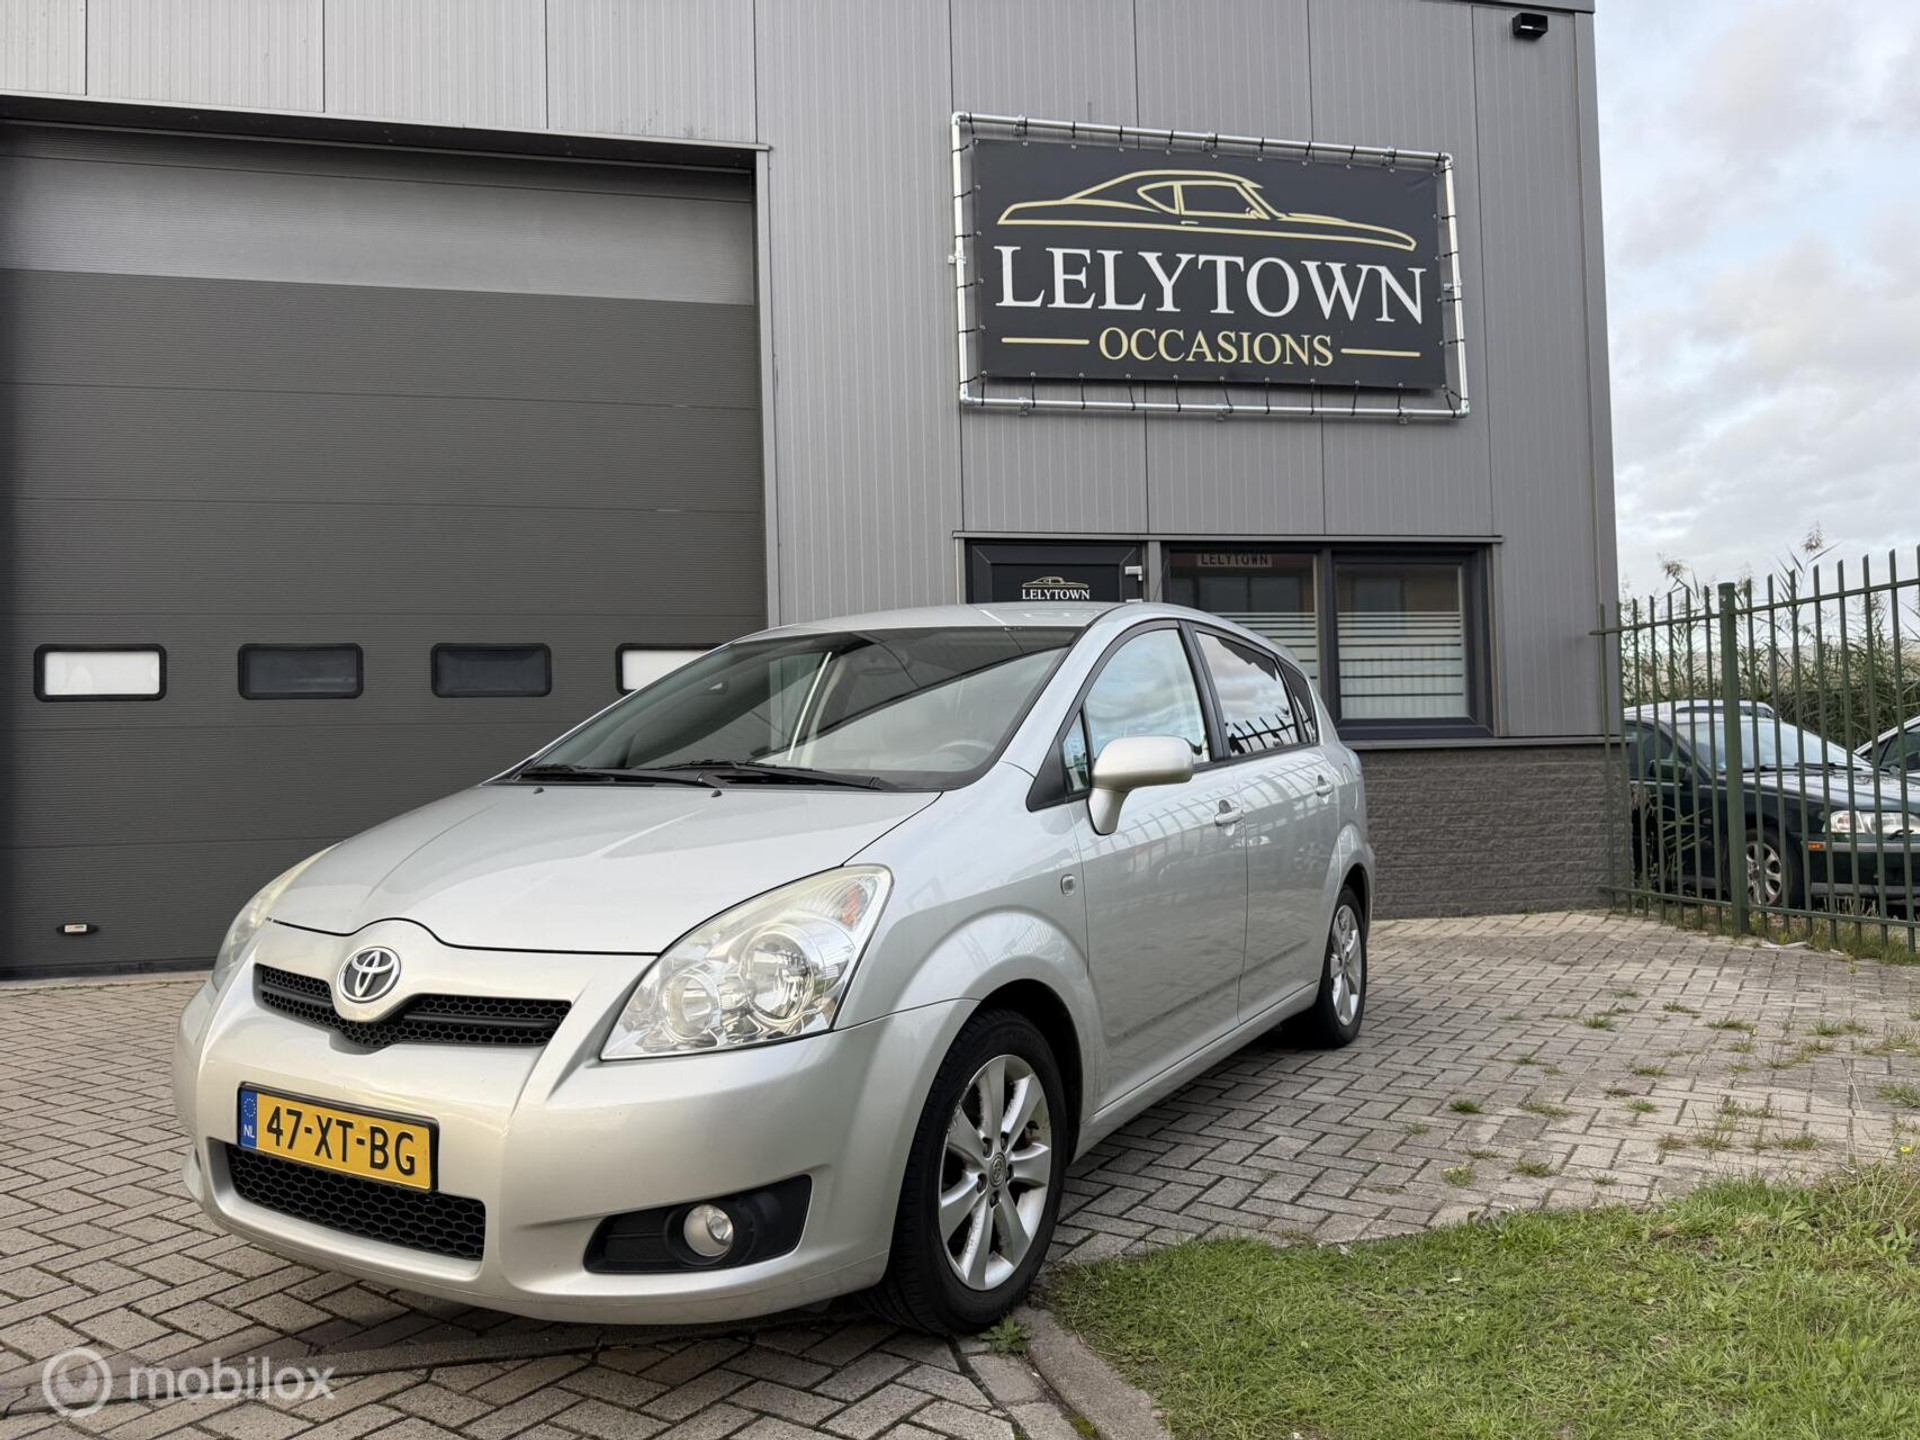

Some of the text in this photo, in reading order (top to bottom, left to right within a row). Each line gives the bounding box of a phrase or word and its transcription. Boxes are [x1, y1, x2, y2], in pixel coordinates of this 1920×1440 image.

[994, 245, 1427, 325] LELYTOWN
[1099, 327, 1334, 367] OCCASIONS
[1200, 551, 1269, 566] LELYTOWN
[1022, 589, 1090, 600] LELYTOWN
[244, 1124, 256, 1139] NL
[266, 1105, 416, 1176] 47-XT-BG
